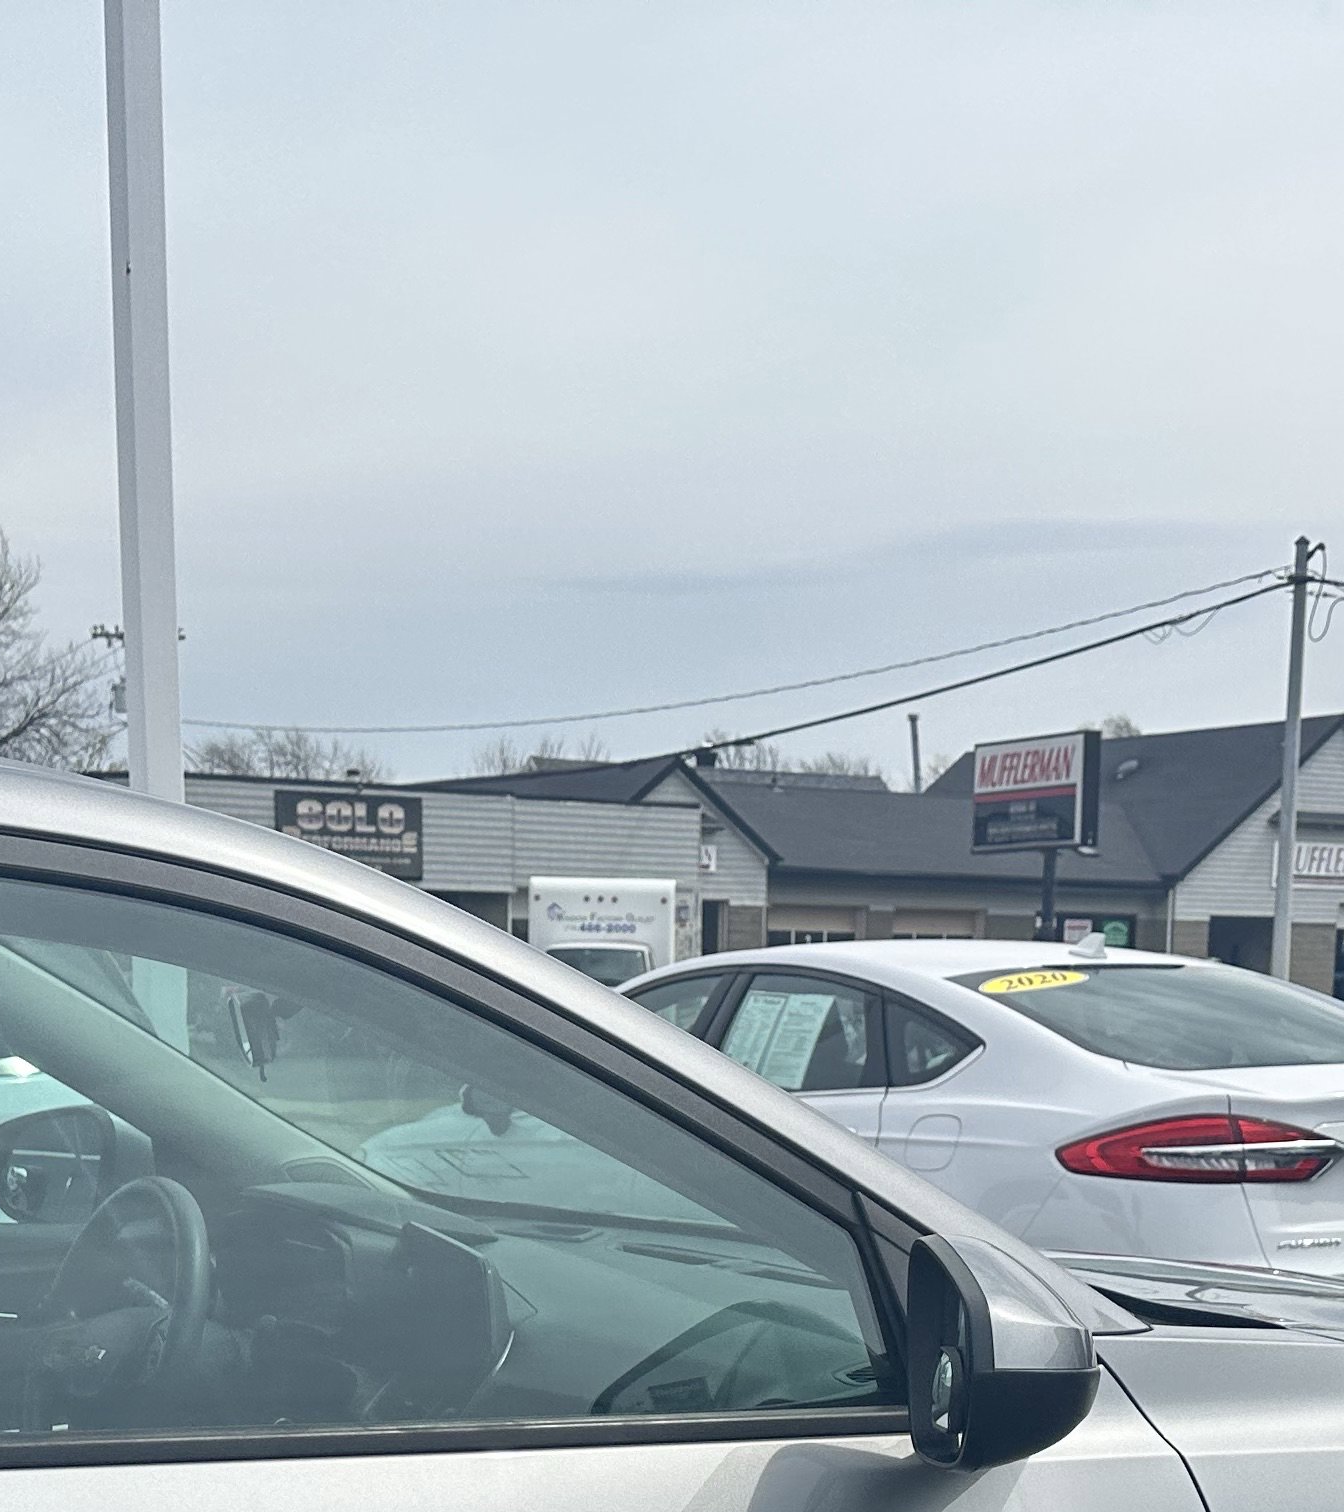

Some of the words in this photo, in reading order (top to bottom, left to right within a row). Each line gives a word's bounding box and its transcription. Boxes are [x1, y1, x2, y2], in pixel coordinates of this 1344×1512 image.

[978, 745, 1076, 788] MUFFLERMAN
[296, 799, 406, 835] SOLO
[1000, 972, 1068, 991] 2020
